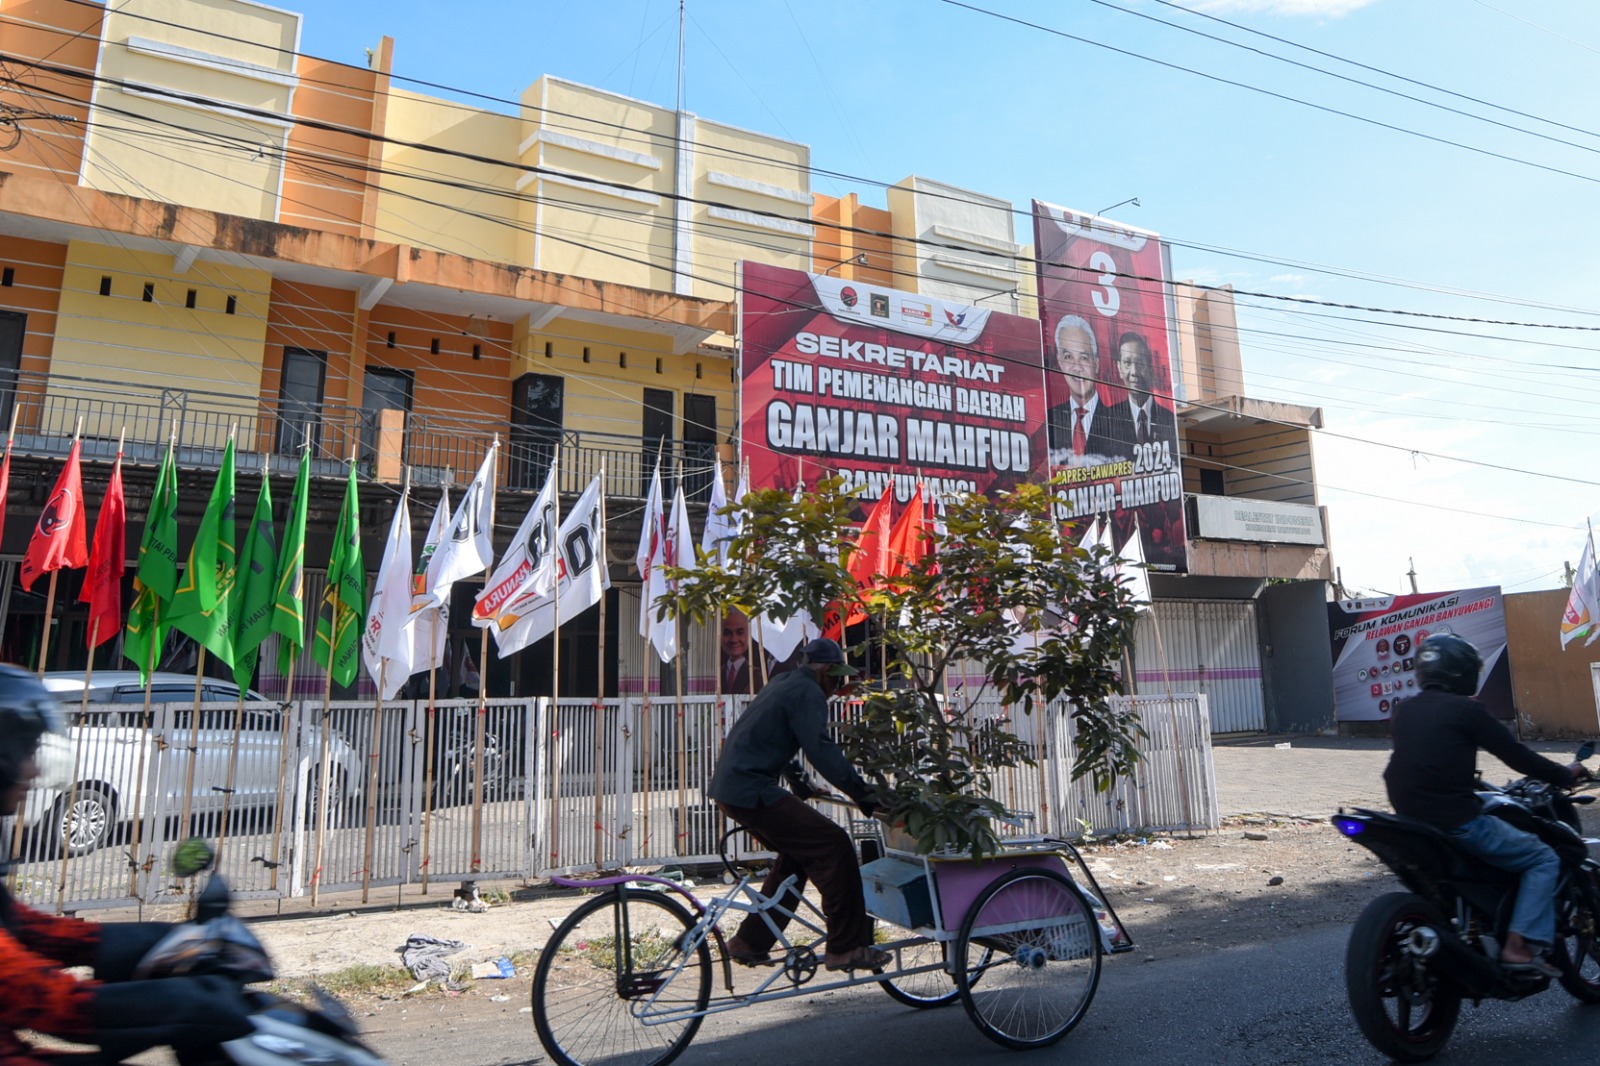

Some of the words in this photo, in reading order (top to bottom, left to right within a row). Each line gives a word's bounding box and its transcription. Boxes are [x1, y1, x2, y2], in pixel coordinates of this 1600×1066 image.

[1089, 251, 1120, 317] 3
[795, 331, 1005, 384] SEKRETARIAT
[771, 359, 813, 393] TIM
[818, 366, 953, 412] PEMENANGAN
[956, 387, 1027, 422] DAERAH
[766, 400, 900, 460] GANJAR
[905, 417, 1031, 473] MAHFUD
[1133, 440, 1172, 475] 2024
[1334, 620, 1376, 641] FORUM
[1381, 596, 1460, 625] KOMUNIKASI
[1365, 624, 1403, 641] RELAWAN
[1404, 614, 1434, 631] GANJAR
[1436, 597, 1495, 622] BANYUWANGI
